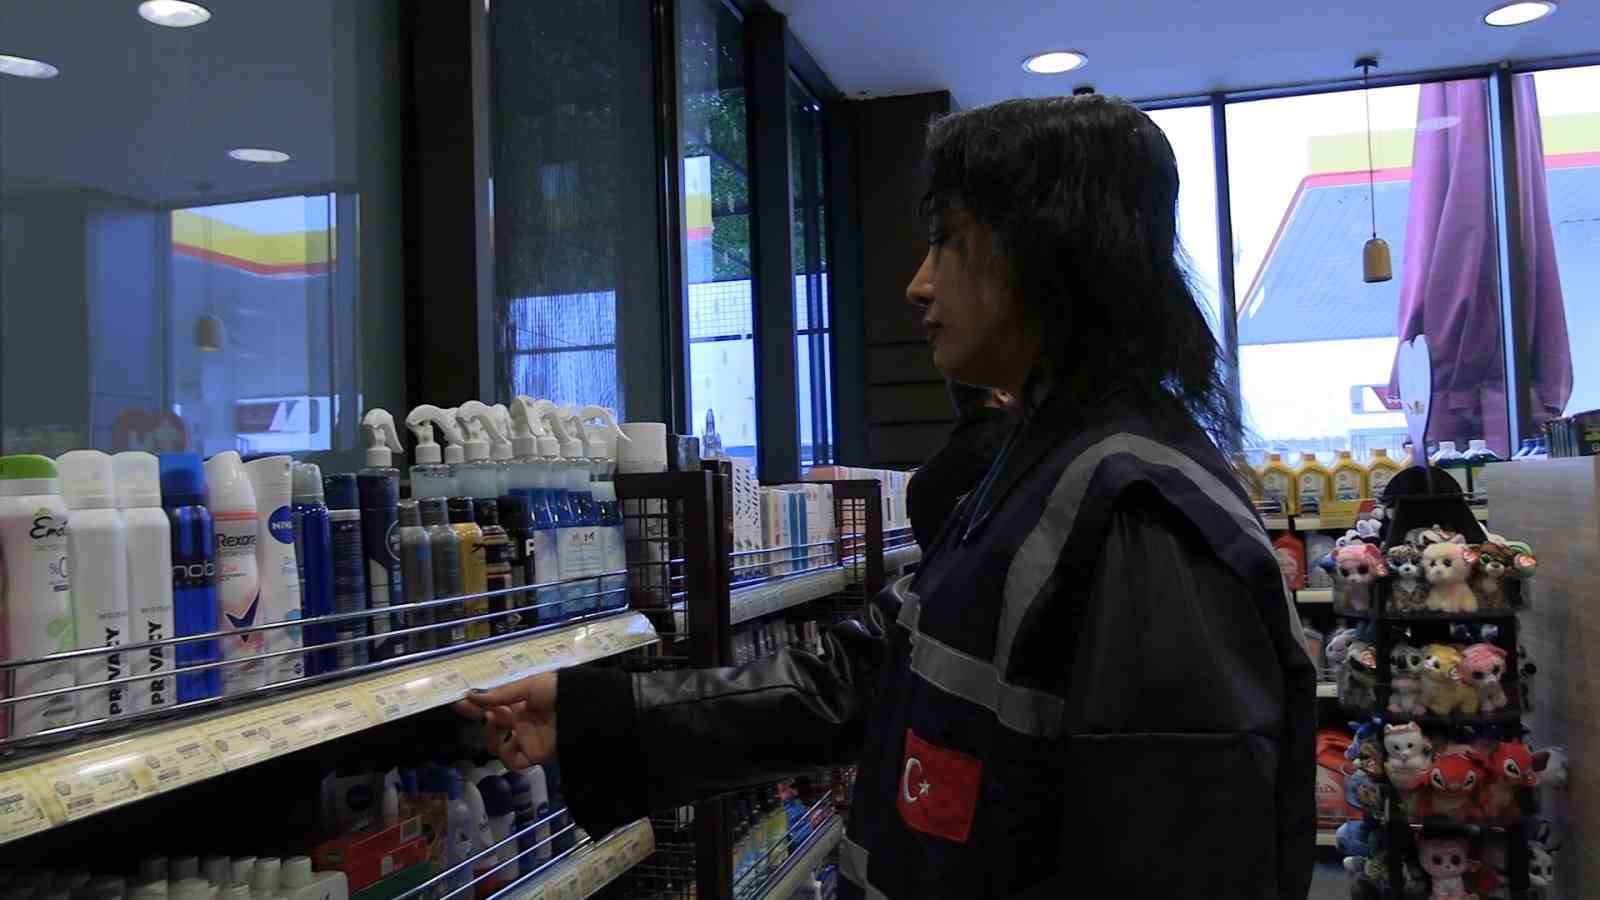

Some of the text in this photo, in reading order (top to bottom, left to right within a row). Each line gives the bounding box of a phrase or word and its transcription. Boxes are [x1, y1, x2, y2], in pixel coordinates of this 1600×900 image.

[216, 533, 257, 547] Rexon
[106, 627, 122, 715] PRVAY
[147, 620, 165, 706] PRVACY
